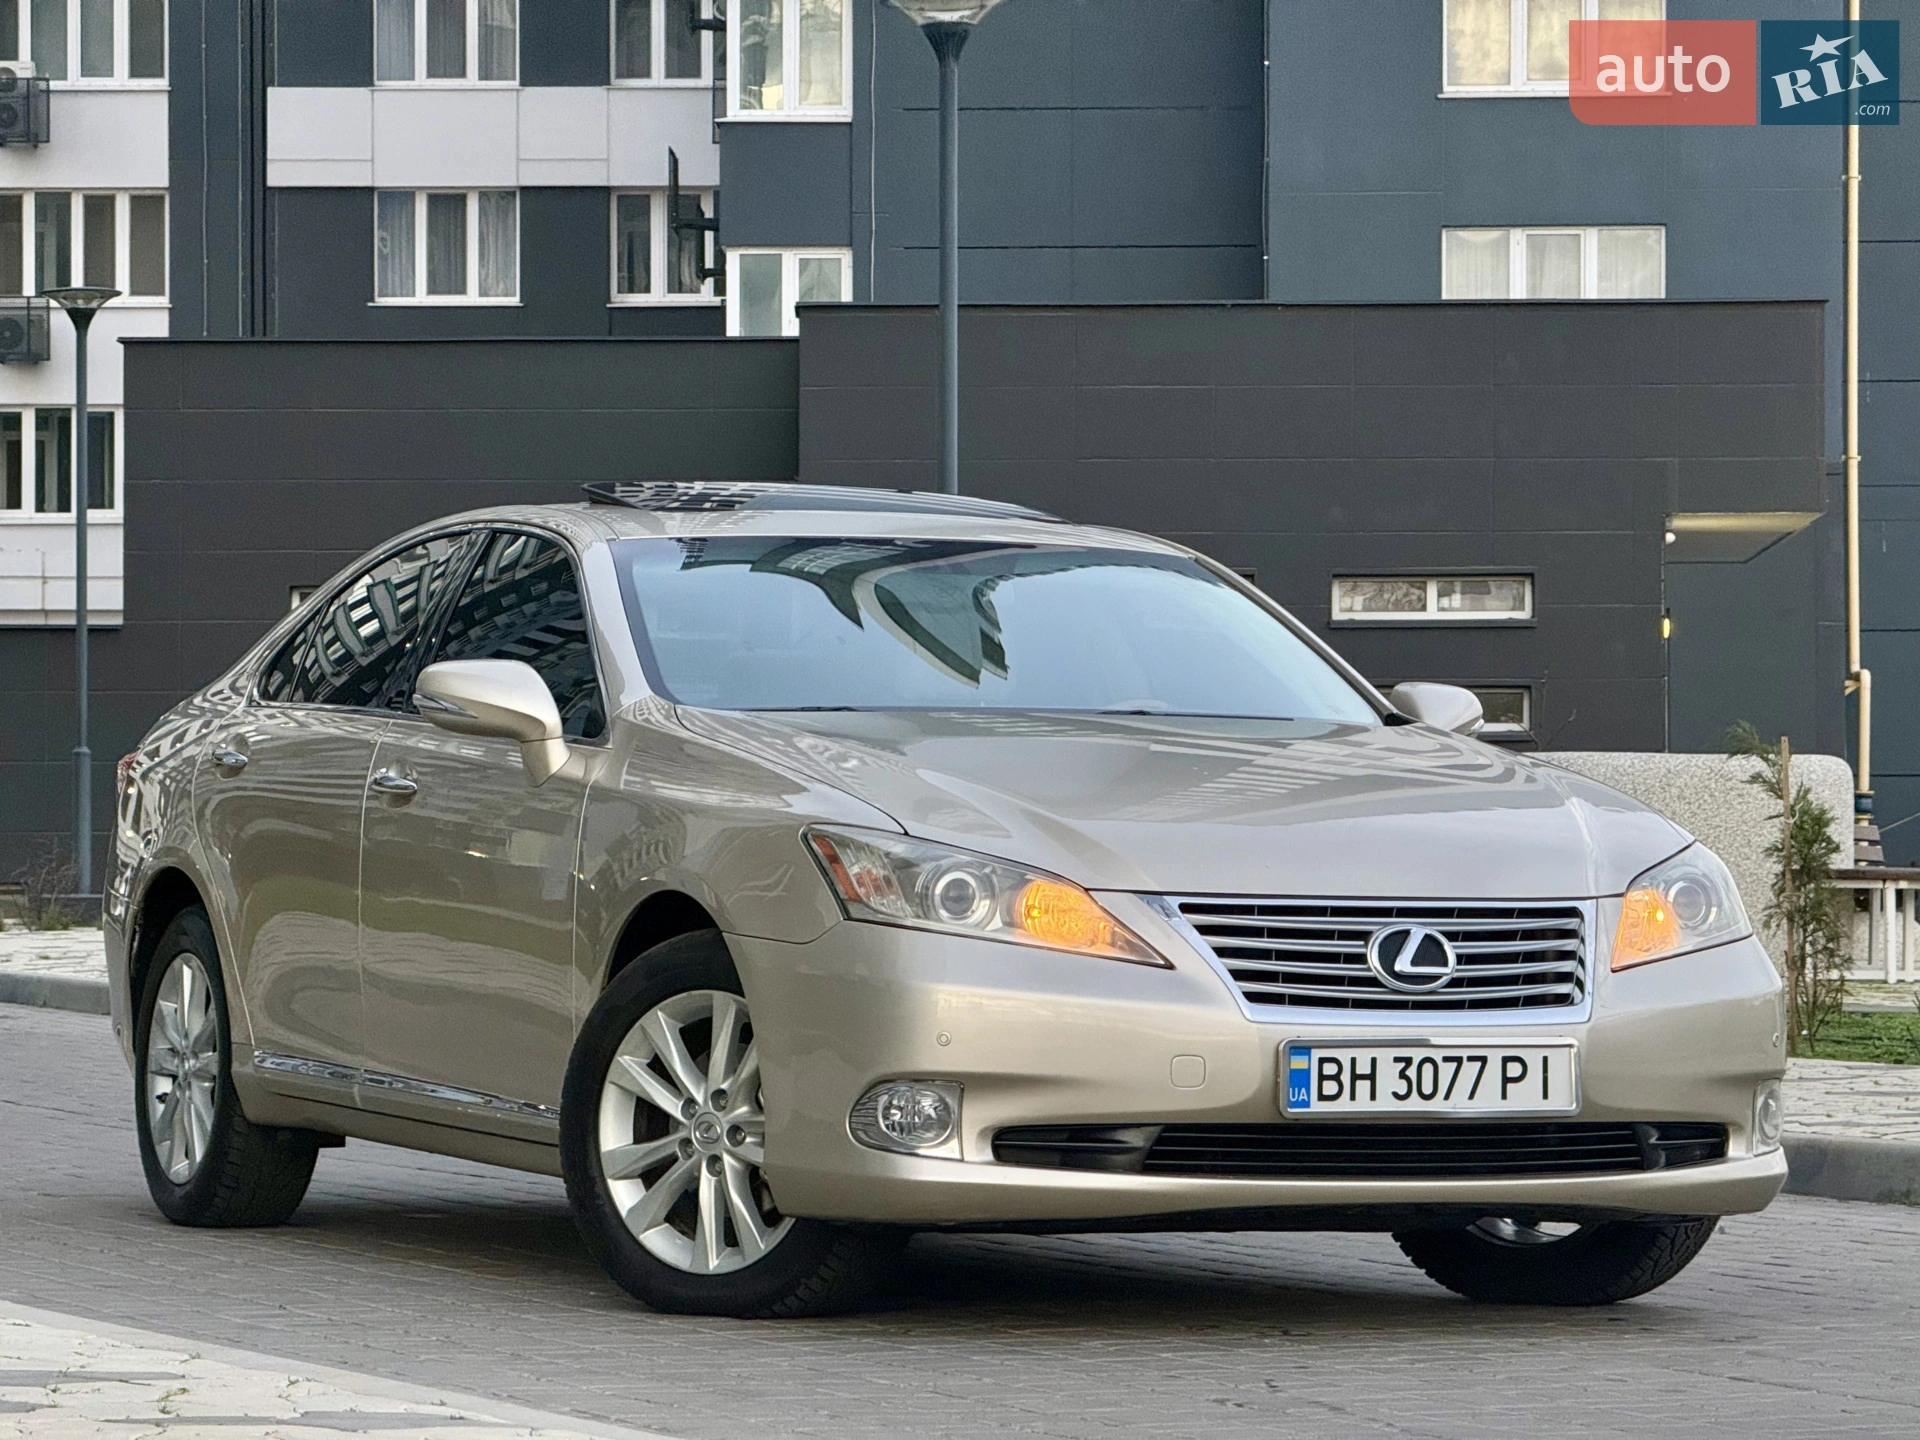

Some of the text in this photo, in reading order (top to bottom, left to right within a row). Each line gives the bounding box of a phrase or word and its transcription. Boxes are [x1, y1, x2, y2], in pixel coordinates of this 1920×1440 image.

[1317, 1055, 1549, 1102] BH 3077 PI
[1289, 1087, 1309, 1102] UA
